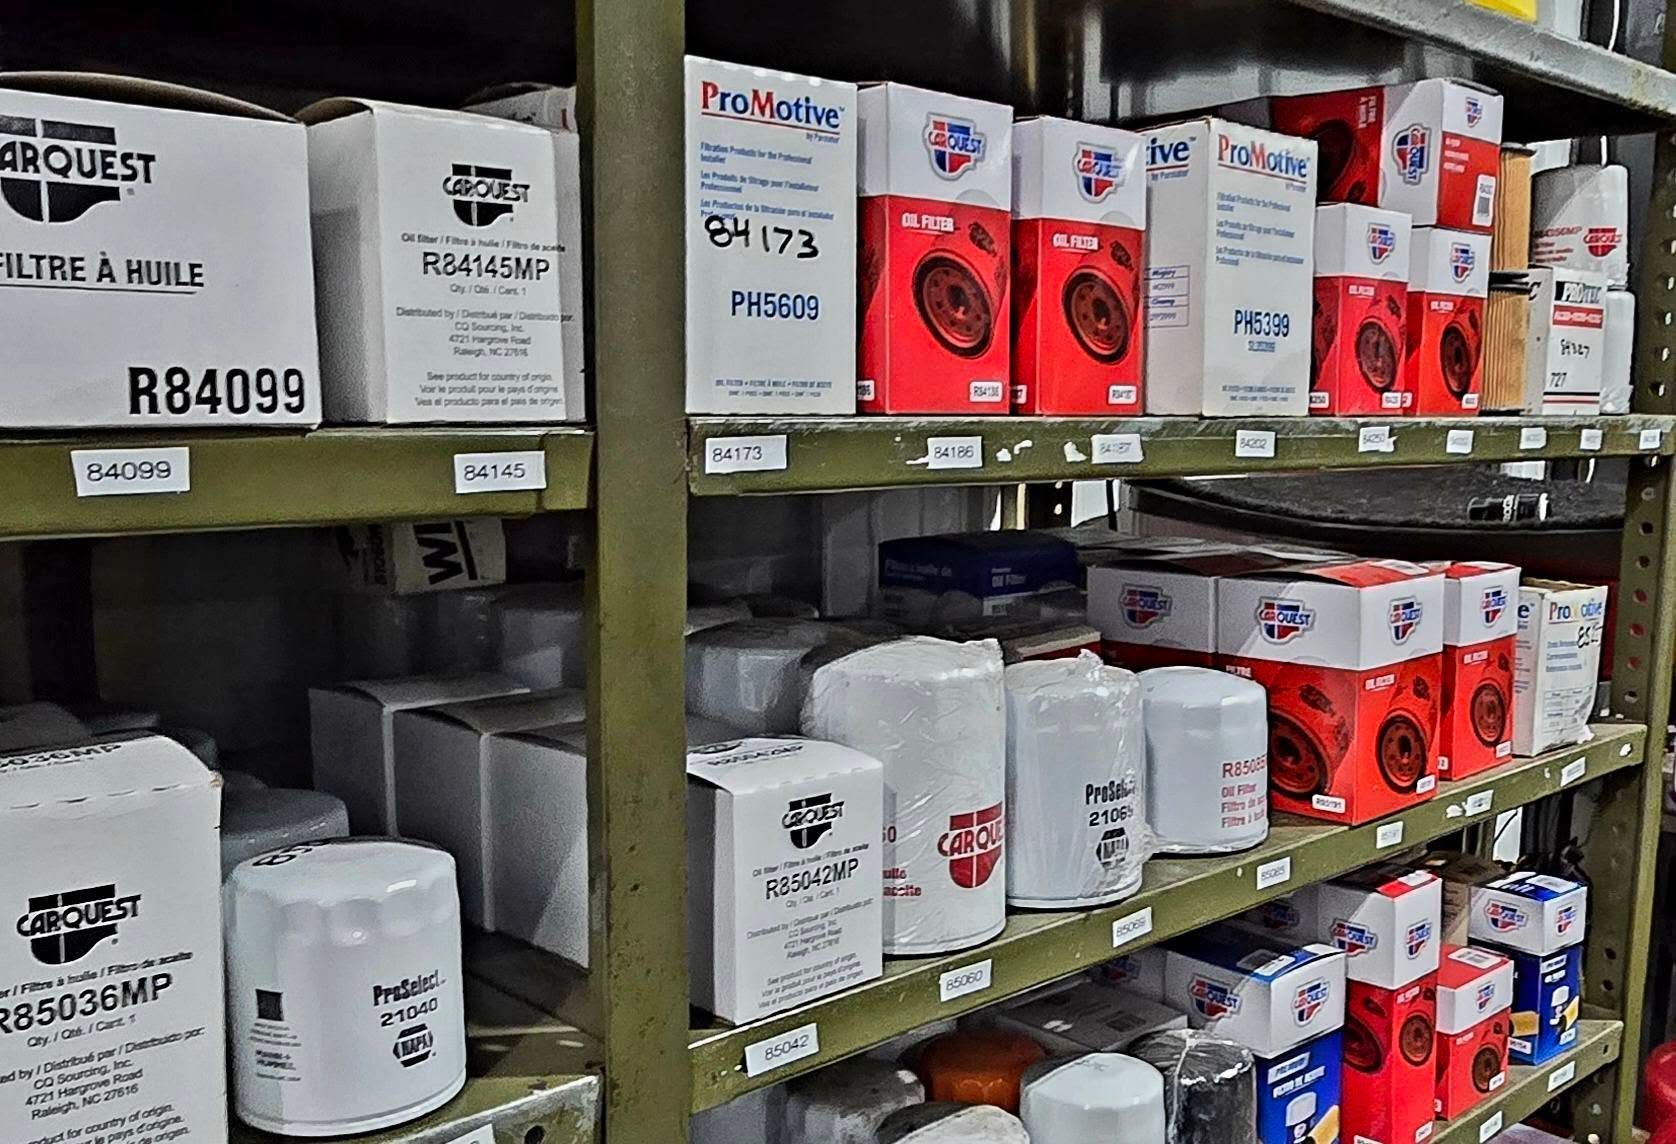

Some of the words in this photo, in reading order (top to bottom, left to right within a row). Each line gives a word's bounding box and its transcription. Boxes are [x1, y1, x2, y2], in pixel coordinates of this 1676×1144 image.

[701, 80, 840, 129] ProMotive
[1218, 133, 1307, 178] ProMotive
[441, 177, 530, 203] CARQUEST
[902, 213, 919, 229] OIL
[921, 215, 954, 232] FILTER
[704, 215, 820, 260] 84173
[97, 251, 117, 283] À
[126, 258, 204, 288] HUILE
[423, 251, 550, 281] R84145MP
[731, 290, 819, 321] PH5609
[1234, 309, 1290, 337] PH5399
[128, 366, 306, 415] R84099
[712, 446, 762, 462] 84173
[934, 445, 974, 458] 84186
[86, 460, 172, 482] 84099
[464, 462, 526, 482] 84145
[1259, 609, 1311, 626] CARQUEST
[1549, 600, 1602, 621] Prootive
[1221, 786, 1235, 798] Oil
[781, 800, 845, 829] CARQUEST
[765, 857, 859, 900] R85042MP
[17, 893, 142, 937] CARQUEST
[372, 969, 439, 1007] ProSelect
[946, 970, 983, 991] 85060
[380, 997, 439, 1027] 21040
[765, 1034, 809, 1061] 85042
[113, 1068, 144, 1084] Road
